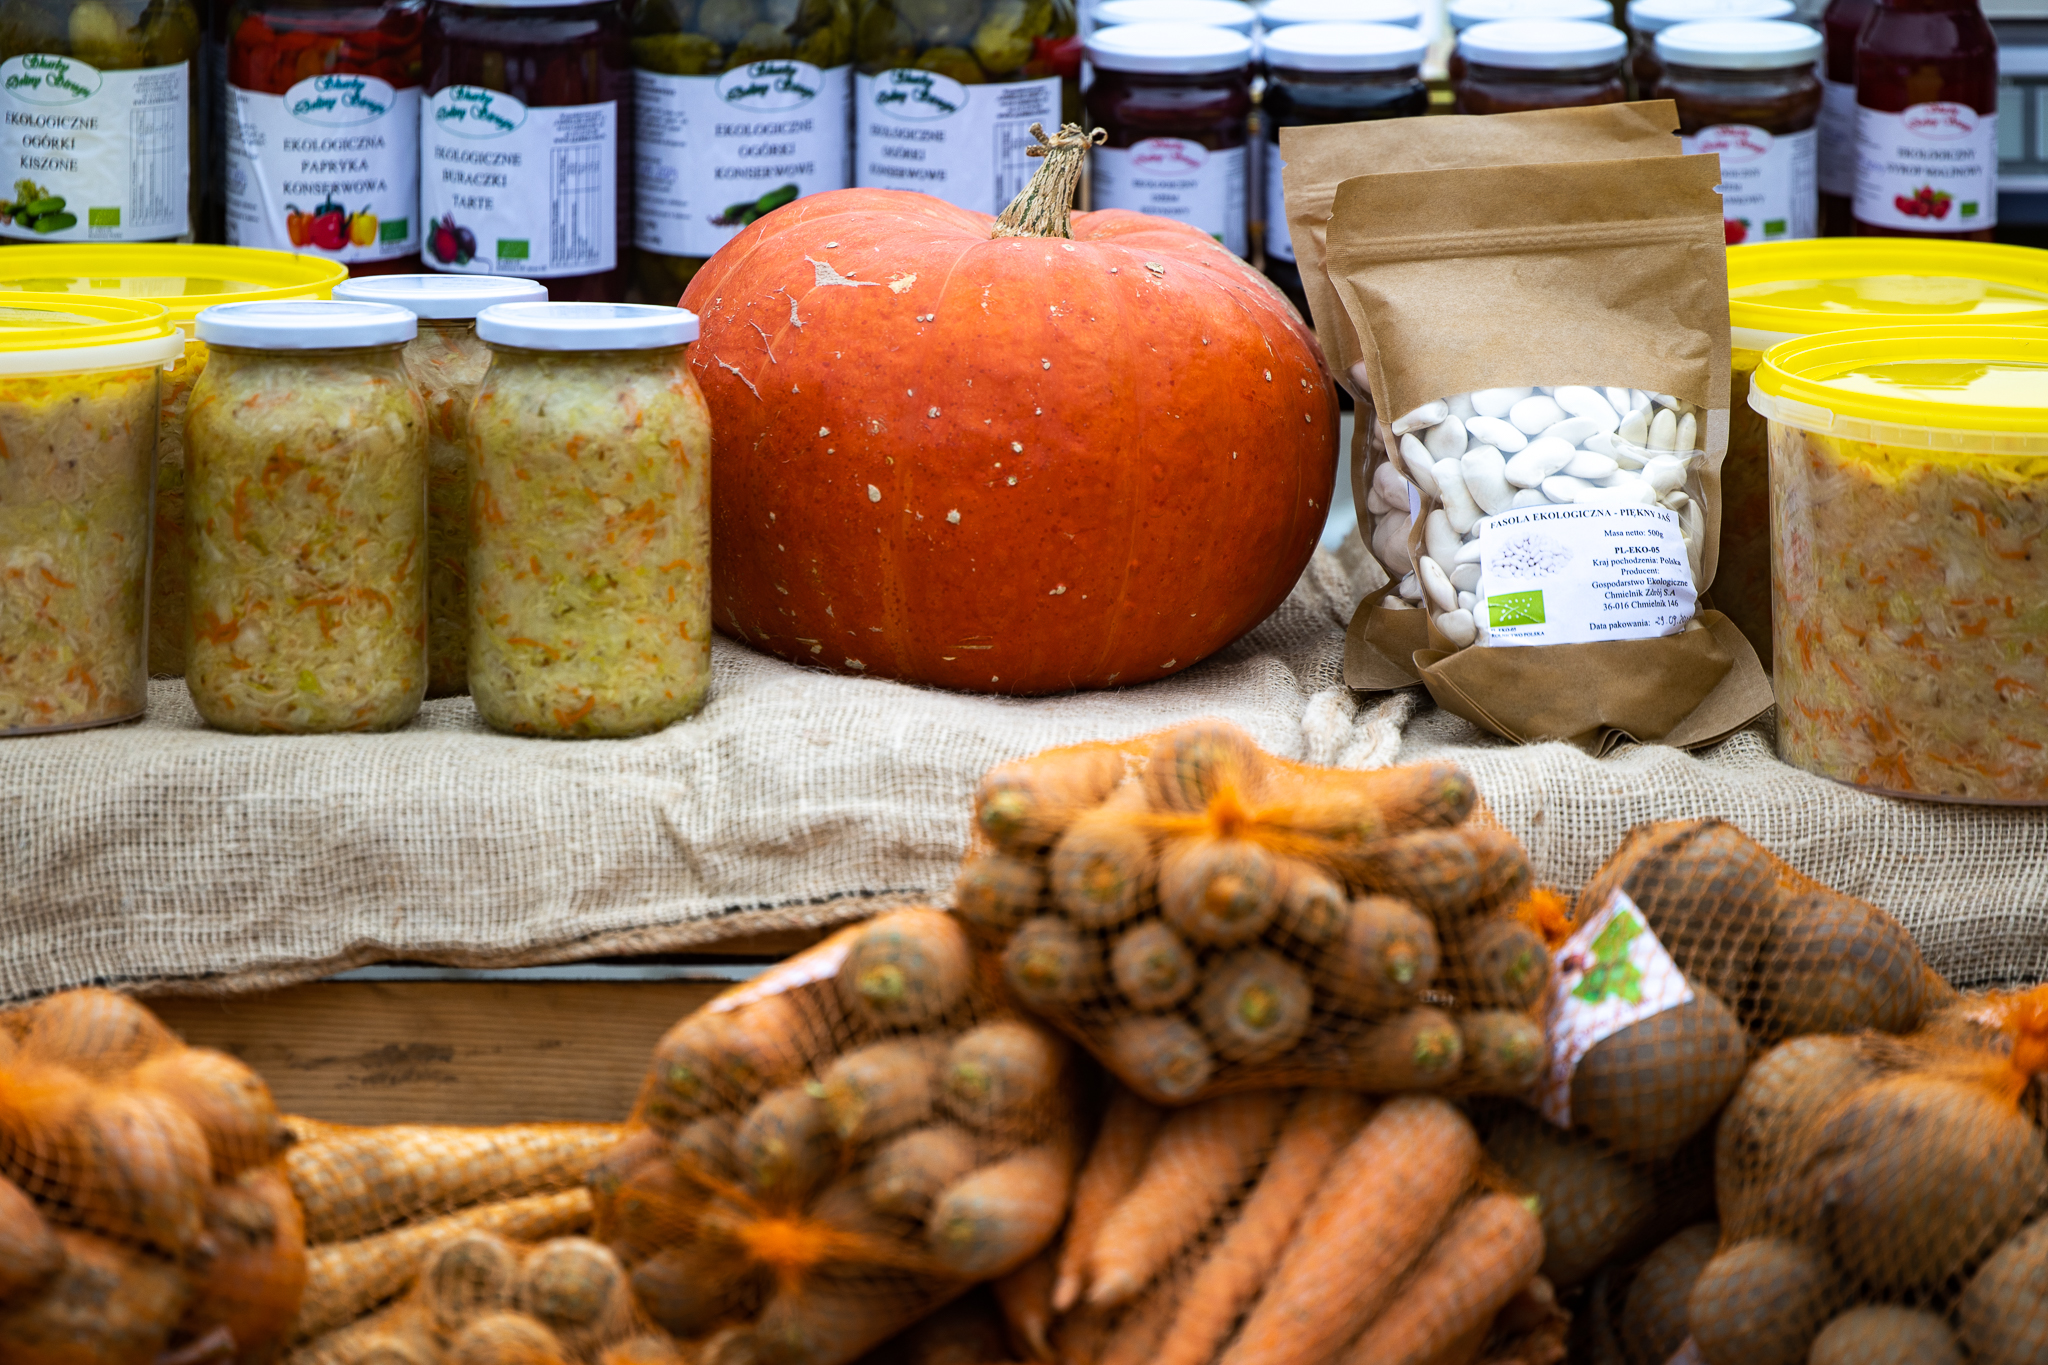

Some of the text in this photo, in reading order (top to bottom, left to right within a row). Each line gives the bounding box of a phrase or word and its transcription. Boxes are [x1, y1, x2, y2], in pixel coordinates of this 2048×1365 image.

[6, 111, 98, 130] EKOLOGICZNE
[714, 118, 815, 138] EKOLOGICZNE
[22, 133, 75, 150] OGÓRKI
[283, 136, 385, 152] EKOLOGICZNA
[20, 155, 78, 172] KISZONE
[434, 145, 523, 167] EKOLOGICZNE
[301, 158, 369, 174] PAPRYKA
[714, 161, 815, 181] KONSERWOWE
[442, 168, 507, 188] BURACZKI
[283, 178, 387, 195] KONSERWOWA
[452, 194, 494, 211] TARTE
[1490, 515, 1530, 529] FASOLA
[1532, 509, 1611, 521] EKOLOGICZNA
[1620, 508, 1656, 518] PIĘKNY
[1657, 511, 1671, 522] JAŚ
[1604, 528, 1664, 539] Masa netto: 500g
[1614, 546, 1660, 554] PL-EKO-05
[1592, 556, 1682, 567] Kraj pochodzenia: Polska
[1621, 567, 1660, 576] Producent:
[1591, 577, 1689, 590] Gospodarstwo Ekologiczne
[1604, 589, 1644, 600] Chmielnik
[1645, 588, 1662, 598] Zdrój
[1603, 599, 1679, 611] 36-016 Chmielnik 146
[1589, 622, 1607, 630] Data
[1608, 619, 1651, 631] pakowania:
